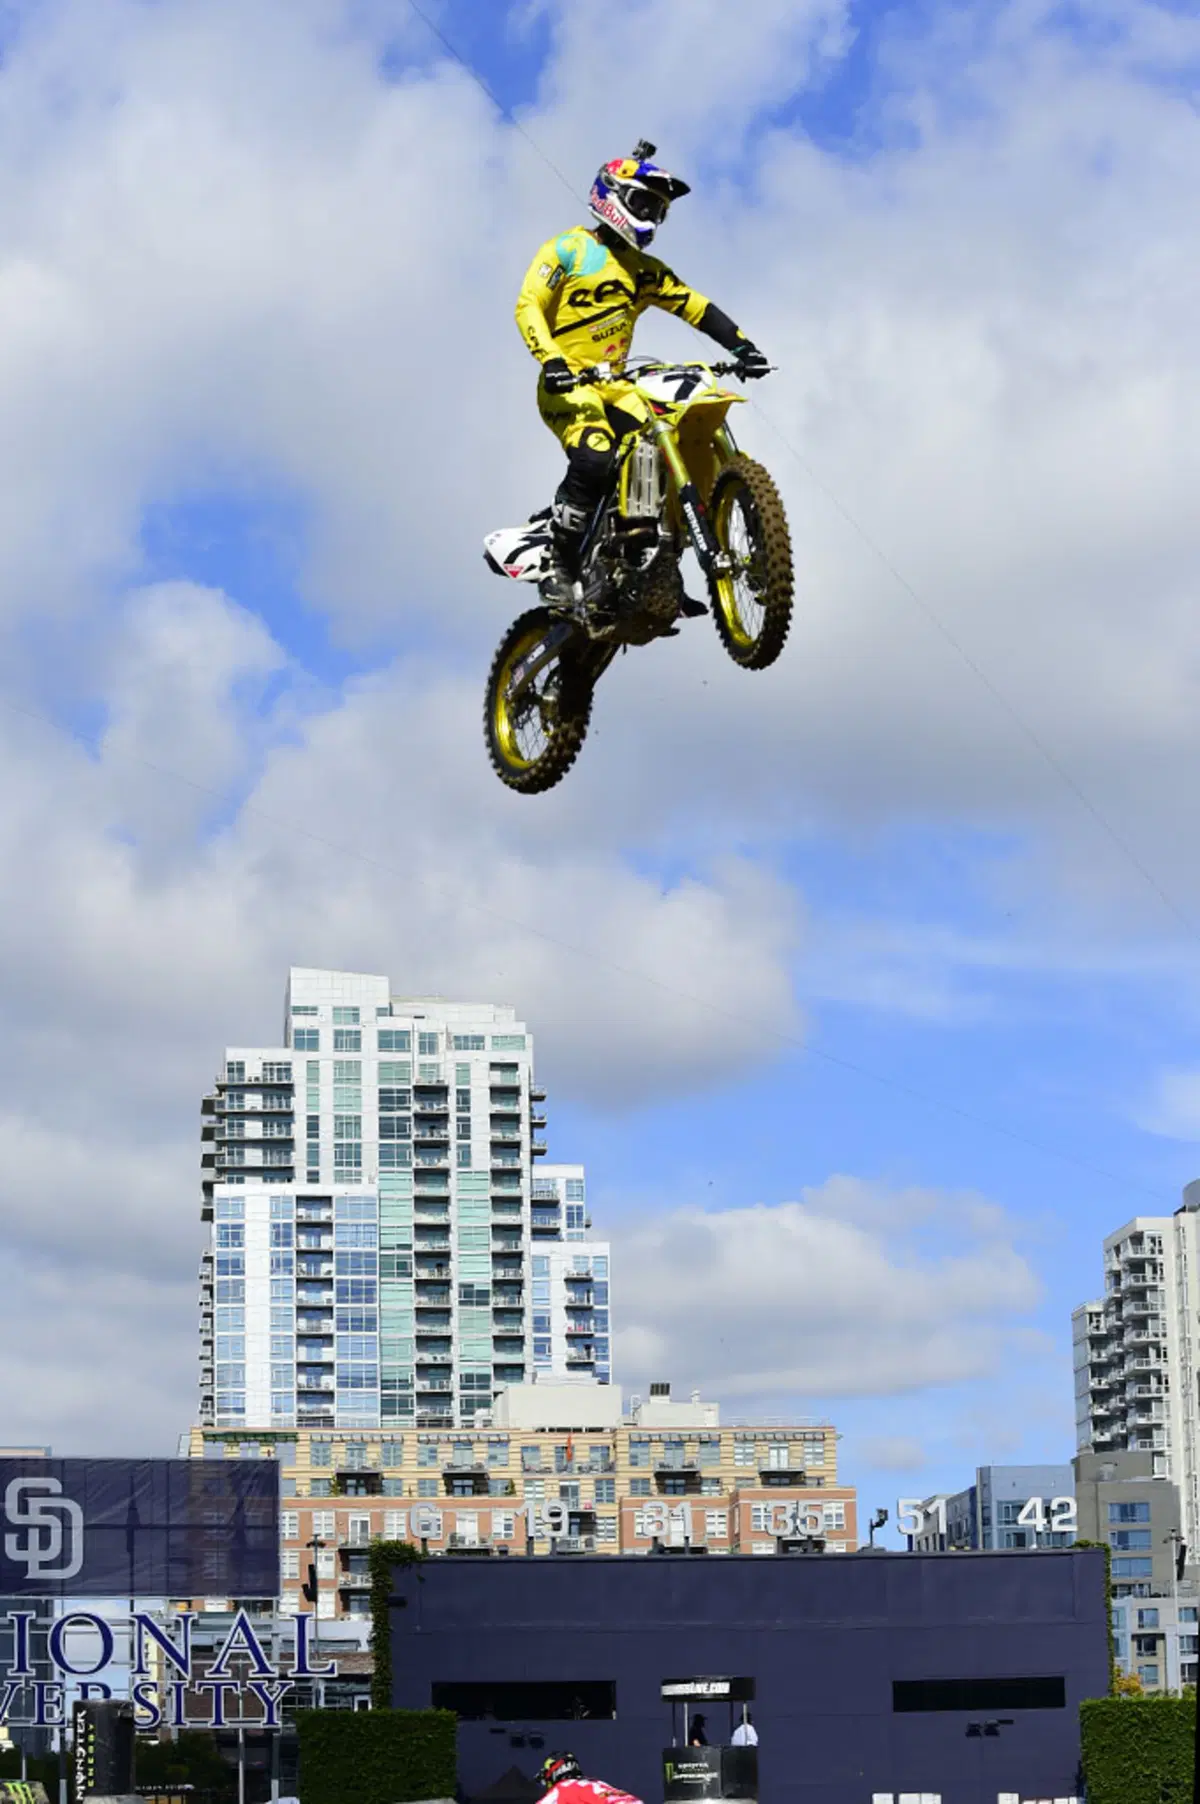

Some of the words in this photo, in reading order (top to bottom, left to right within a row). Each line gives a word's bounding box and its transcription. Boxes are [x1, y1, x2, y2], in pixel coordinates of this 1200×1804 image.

[603, 203, 628, 231] Bull
[663, 373, 701, 402] 7
[4, 1477, 84, 1580] SD
[514, 1499, 569, 1537] 19
[642, 1500, 693, 1538] 31
[765, 1500, 826, 1537] 35
[897, 1498, 947, 1535] 51
[1017, 1496, 1078, 1532] 42
[7, 1607, 338, 1678] IONAL
[75, 1709, 87, 1800] MONSTER
